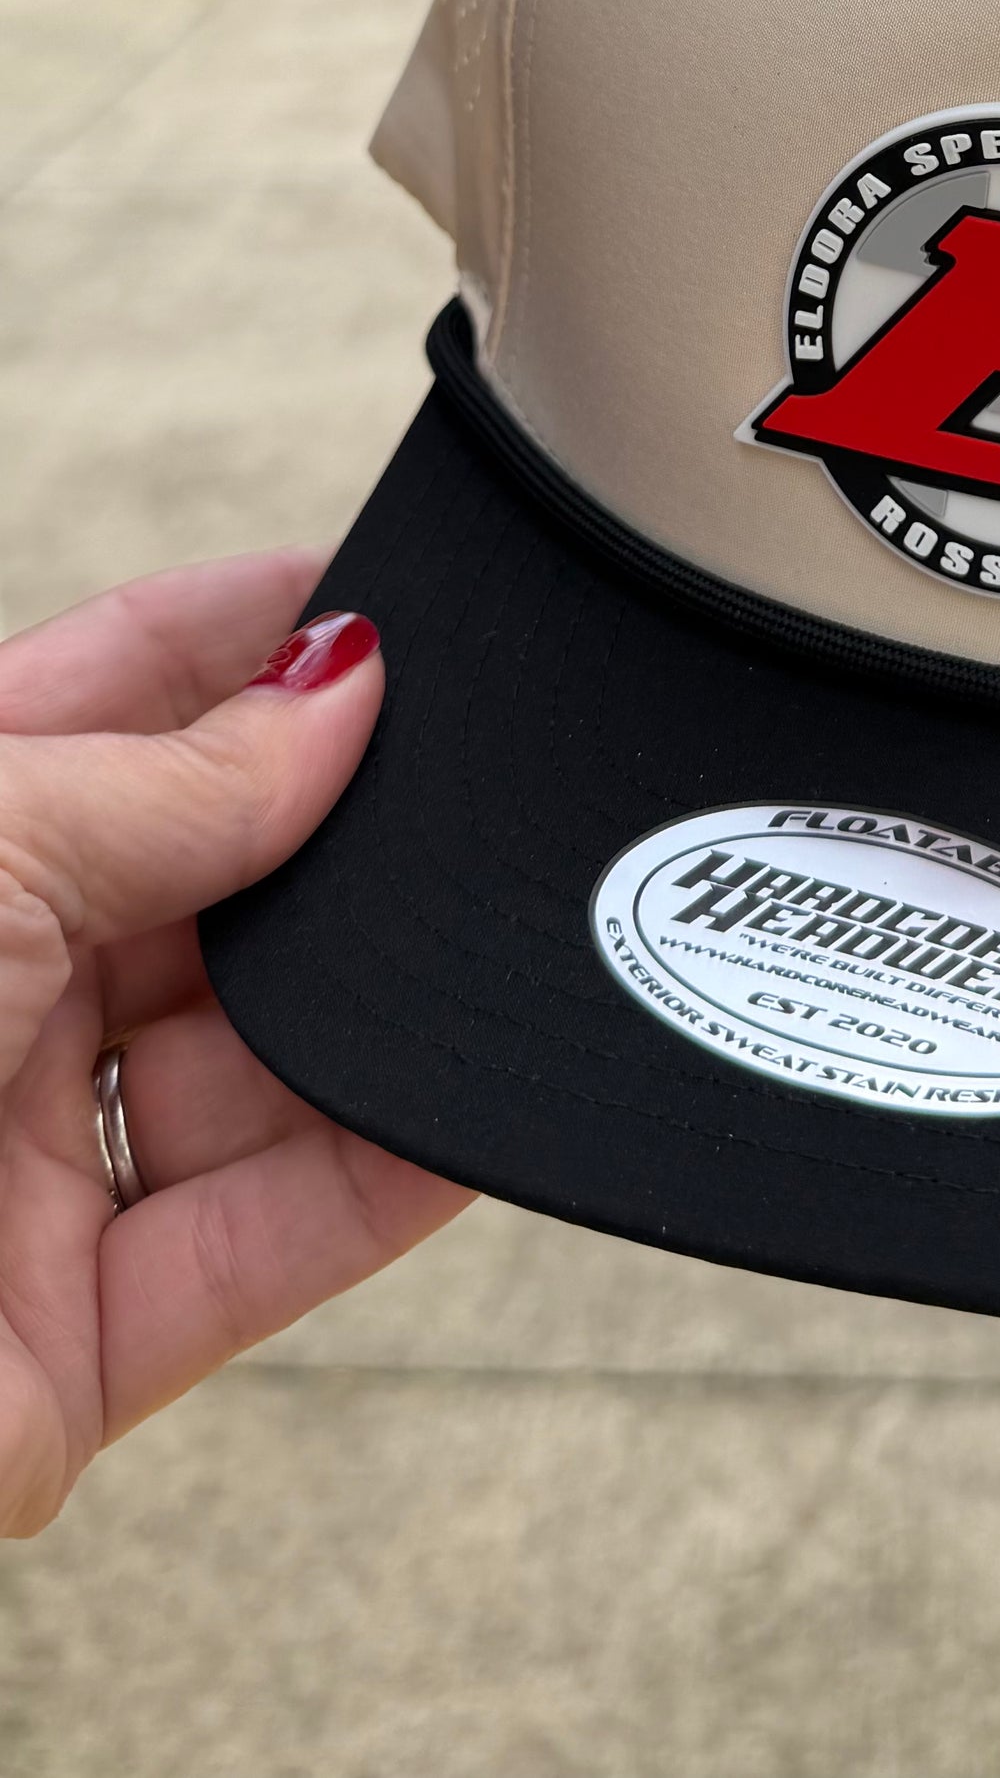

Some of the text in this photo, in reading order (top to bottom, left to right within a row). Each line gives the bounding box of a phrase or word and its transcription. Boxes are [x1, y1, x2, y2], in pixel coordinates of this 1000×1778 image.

[794, 172, 892, 361] ELDORA
[606, 917, 704, 1025] EXTERIOR
[701, 1021, 818, 1072] SWEAT
[816, 1065, 921, 1099] STAIN
[748, 991, 938, 1054] EST 2020
[829, 956, 905, 985] BUILT
